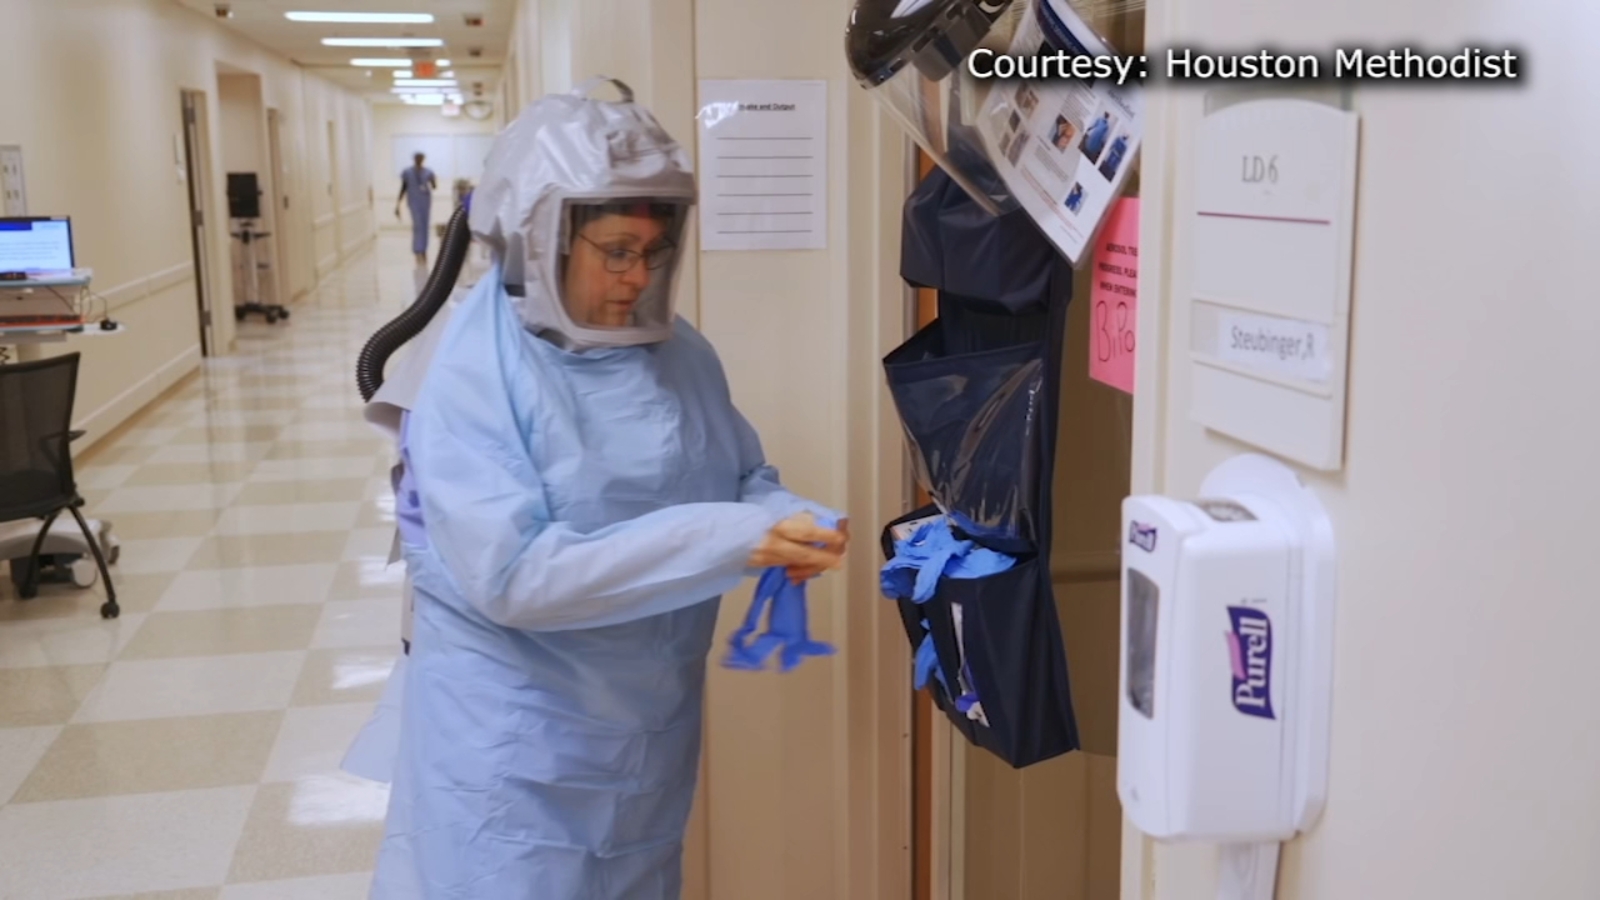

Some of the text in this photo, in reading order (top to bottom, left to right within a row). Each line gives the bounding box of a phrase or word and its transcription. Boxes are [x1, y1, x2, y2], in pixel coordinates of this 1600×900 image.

[1242, 154, 1279, 184] LD 6
[1234, 616, 1268, 708] Purell
